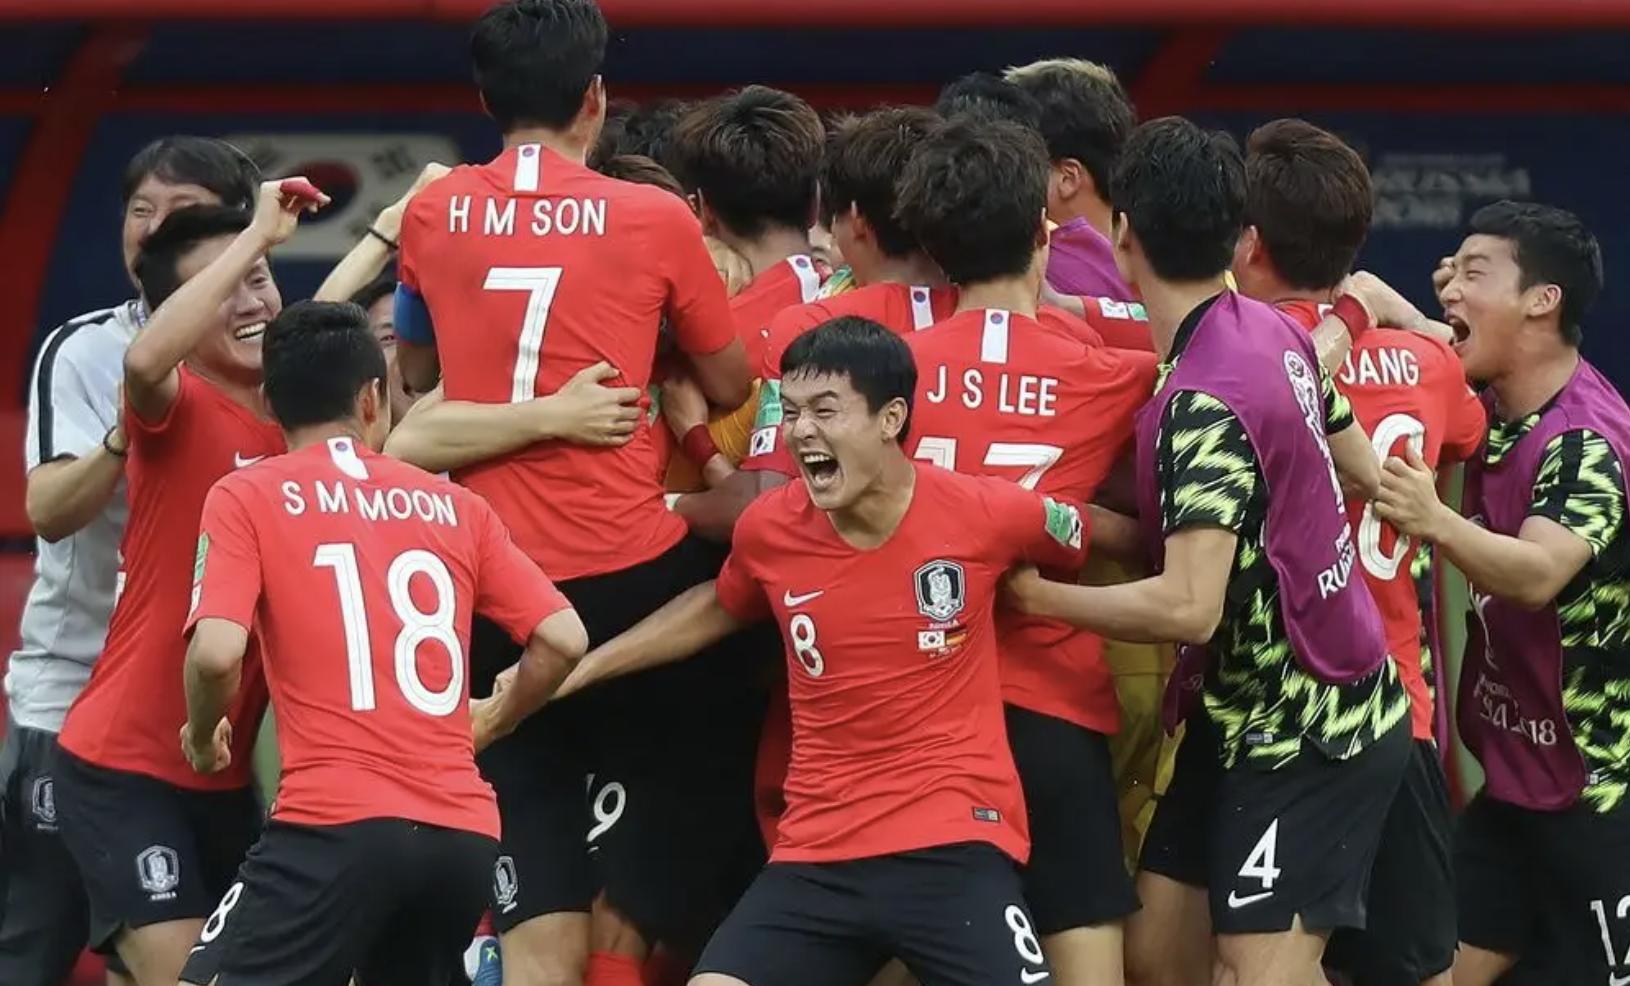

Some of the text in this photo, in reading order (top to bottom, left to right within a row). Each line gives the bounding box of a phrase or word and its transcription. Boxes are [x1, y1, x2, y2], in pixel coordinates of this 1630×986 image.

[449, 196, 606, 236] H M SON
[483, 267, 563, 404] 7
[927, 365, 1058, 416] J S LEE
[1340, 348, 1419, 386] JANG
[281, 481, 457, 526] S M MOON
[313, 542, 465, 717] 18
[790, 614, 824, 678] 8
[587, 774, 626, 842] 9
[1238, 818, 1281, 888] 4
[201, 881, 244, 942] 8
[1005, 904, 1044, 965] 8
